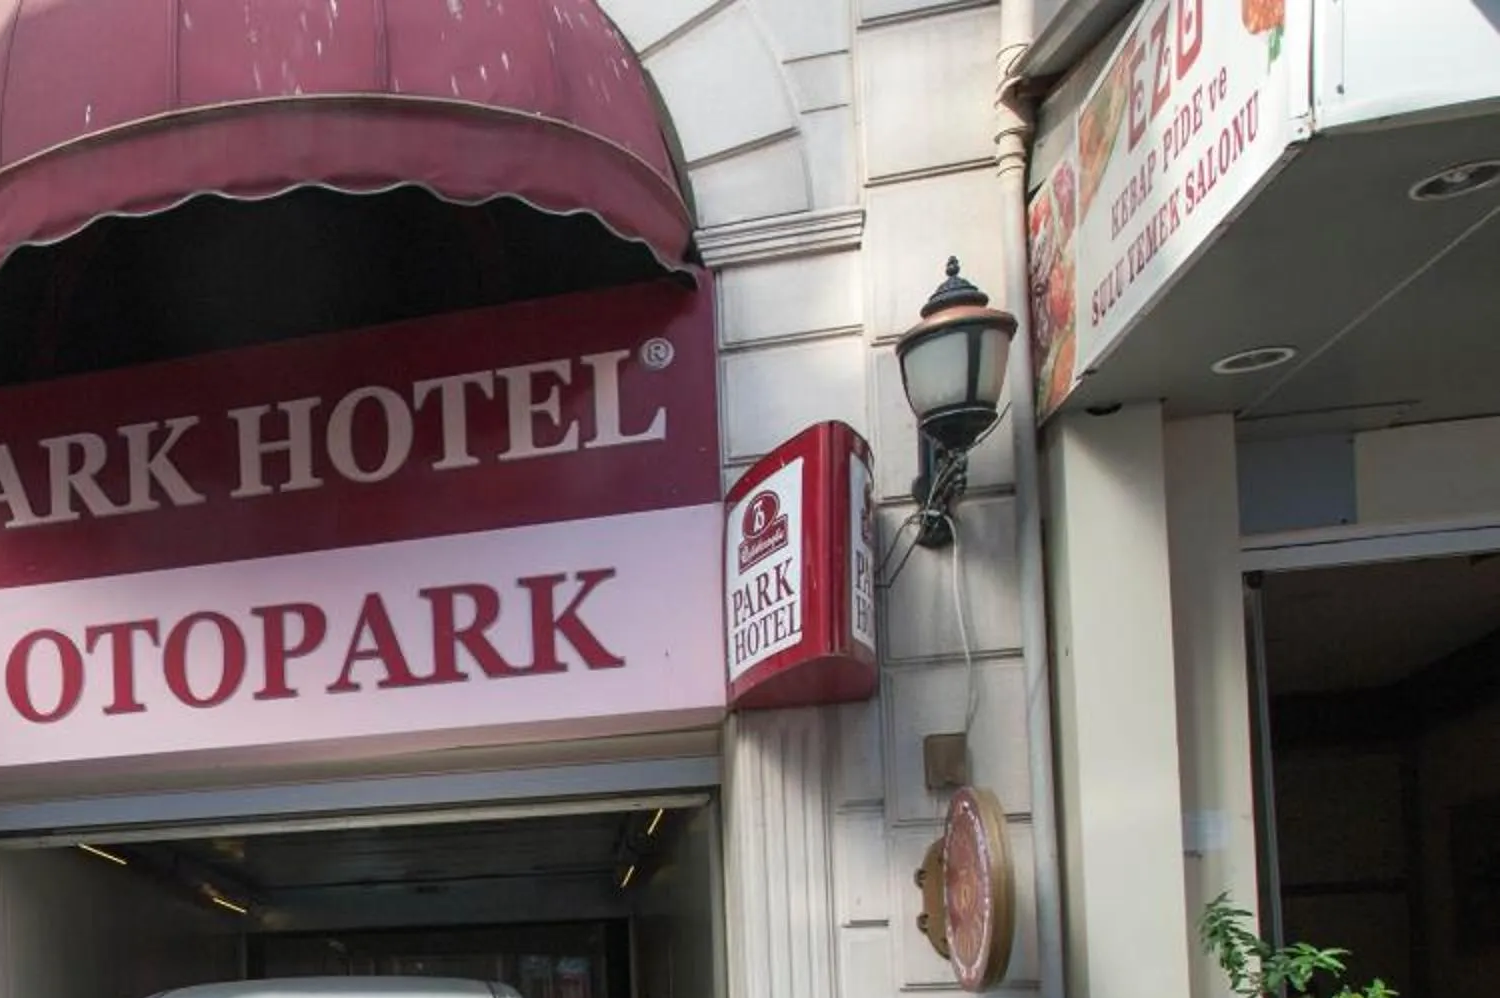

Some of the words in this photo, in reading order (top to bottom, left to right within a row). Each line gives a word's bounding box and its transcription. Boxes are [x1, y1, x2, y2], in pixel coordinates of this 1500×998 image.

[1091, 257, 1125, 328] SULU
[1127, 188, 1181, 284] YEMEK
[1185, 90, 1260, 215] SALONU
[1111, 150, 1156, 241] KEBAP
[1209, 66, 1228, 112] ve
[227, 348, 667, 498] HOTEL
[4, 568, 626, 725] OTOPARK
[732, 557, 795, 630] PARK
[734, 600, 802, 665] HOTEL
